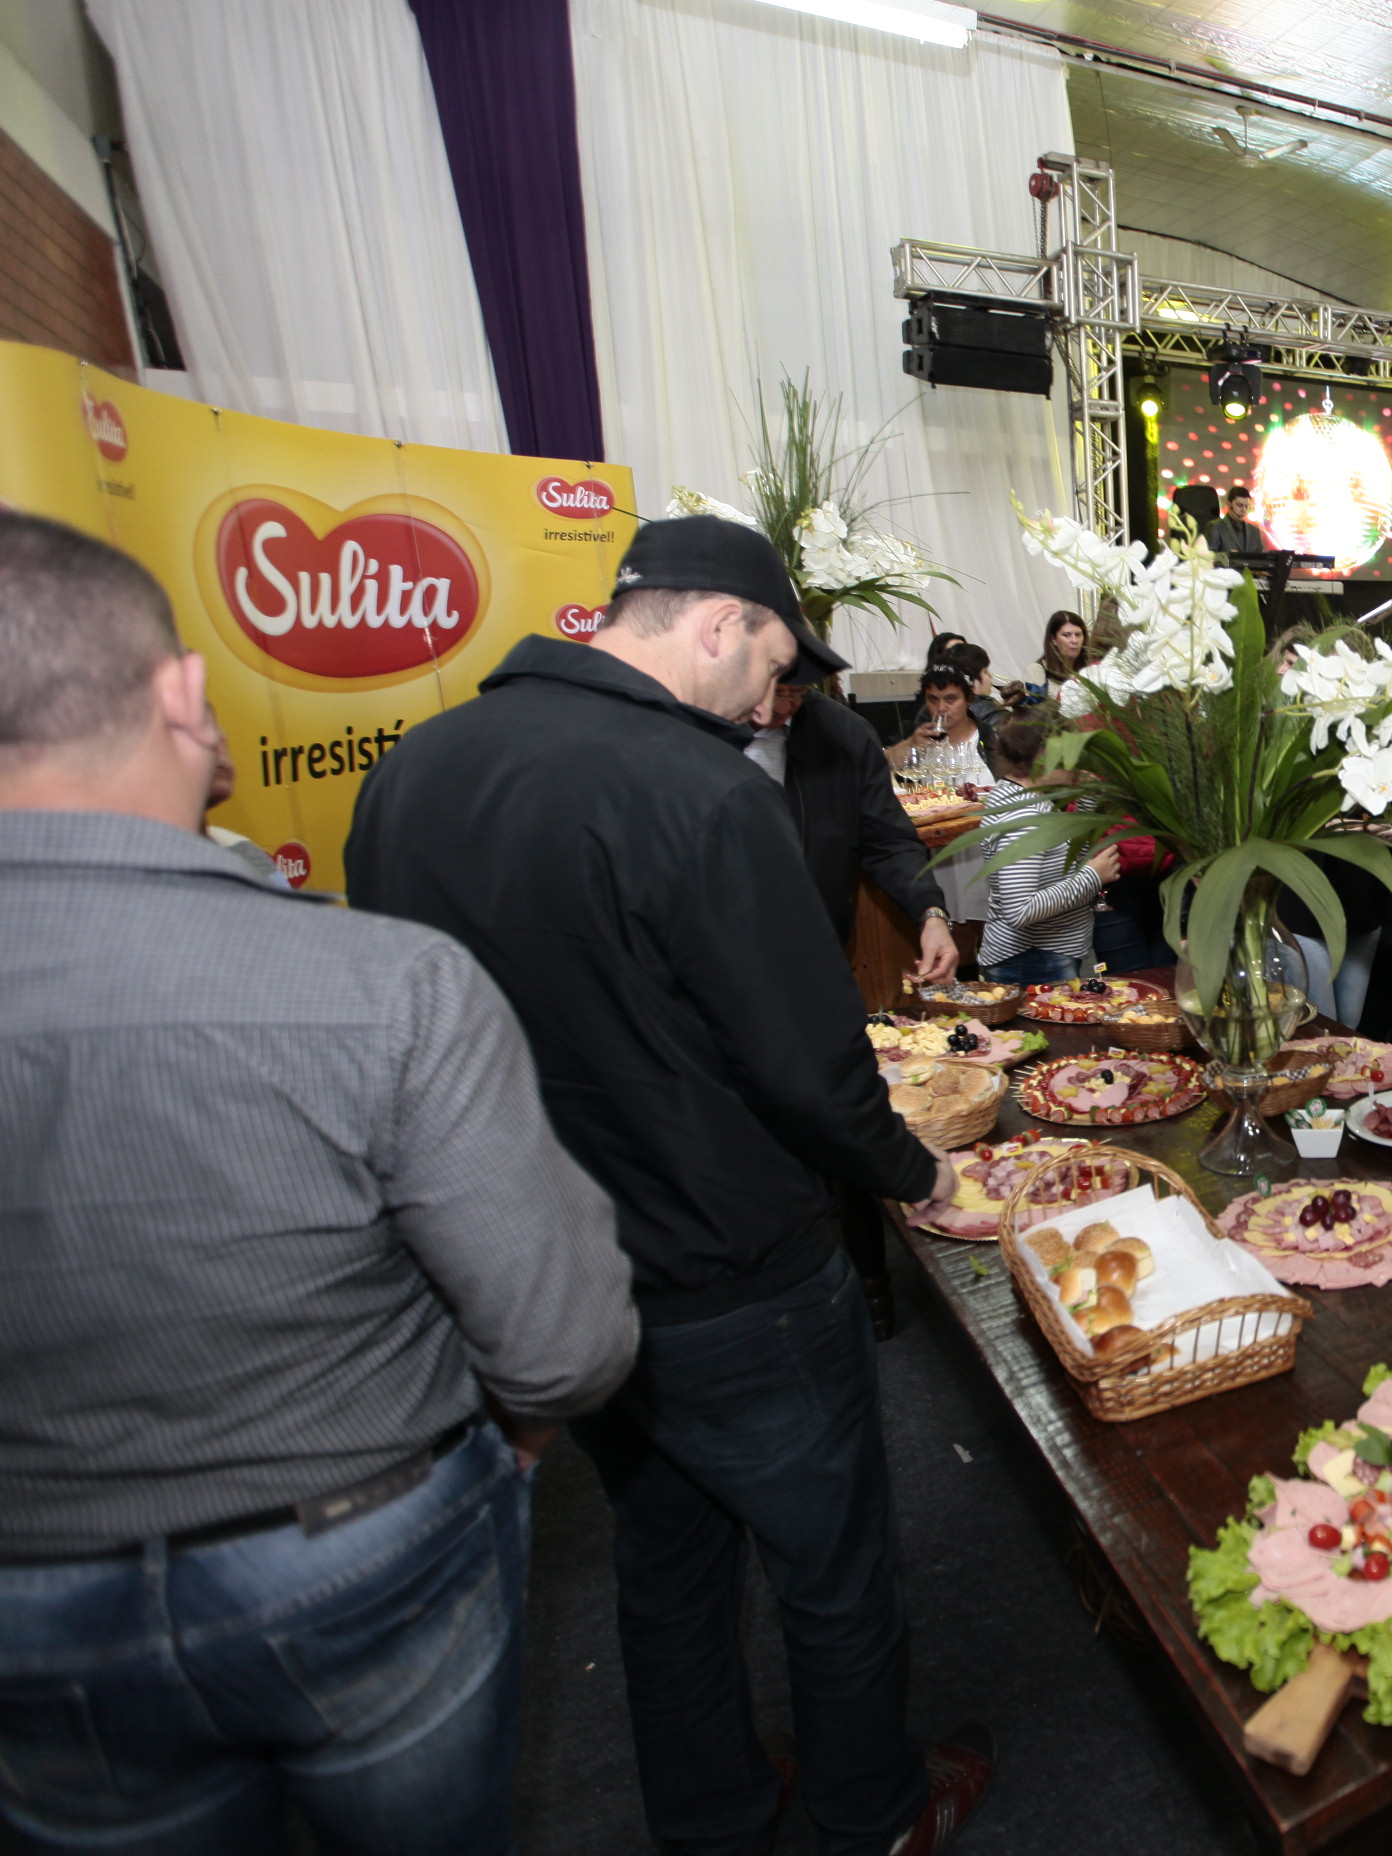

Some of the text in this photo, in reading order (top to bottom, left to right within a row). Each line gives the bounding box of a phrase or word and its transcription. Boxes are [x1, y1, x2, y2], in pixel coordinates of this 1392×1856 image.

[542, 481, 610, 510] Sulita
[544, 529, 615, 543] irresistível!
[234, 521, 460, 636] Sulita
[560, 608, 606, 634] Sul
[276, 854, 307, 879] lita
